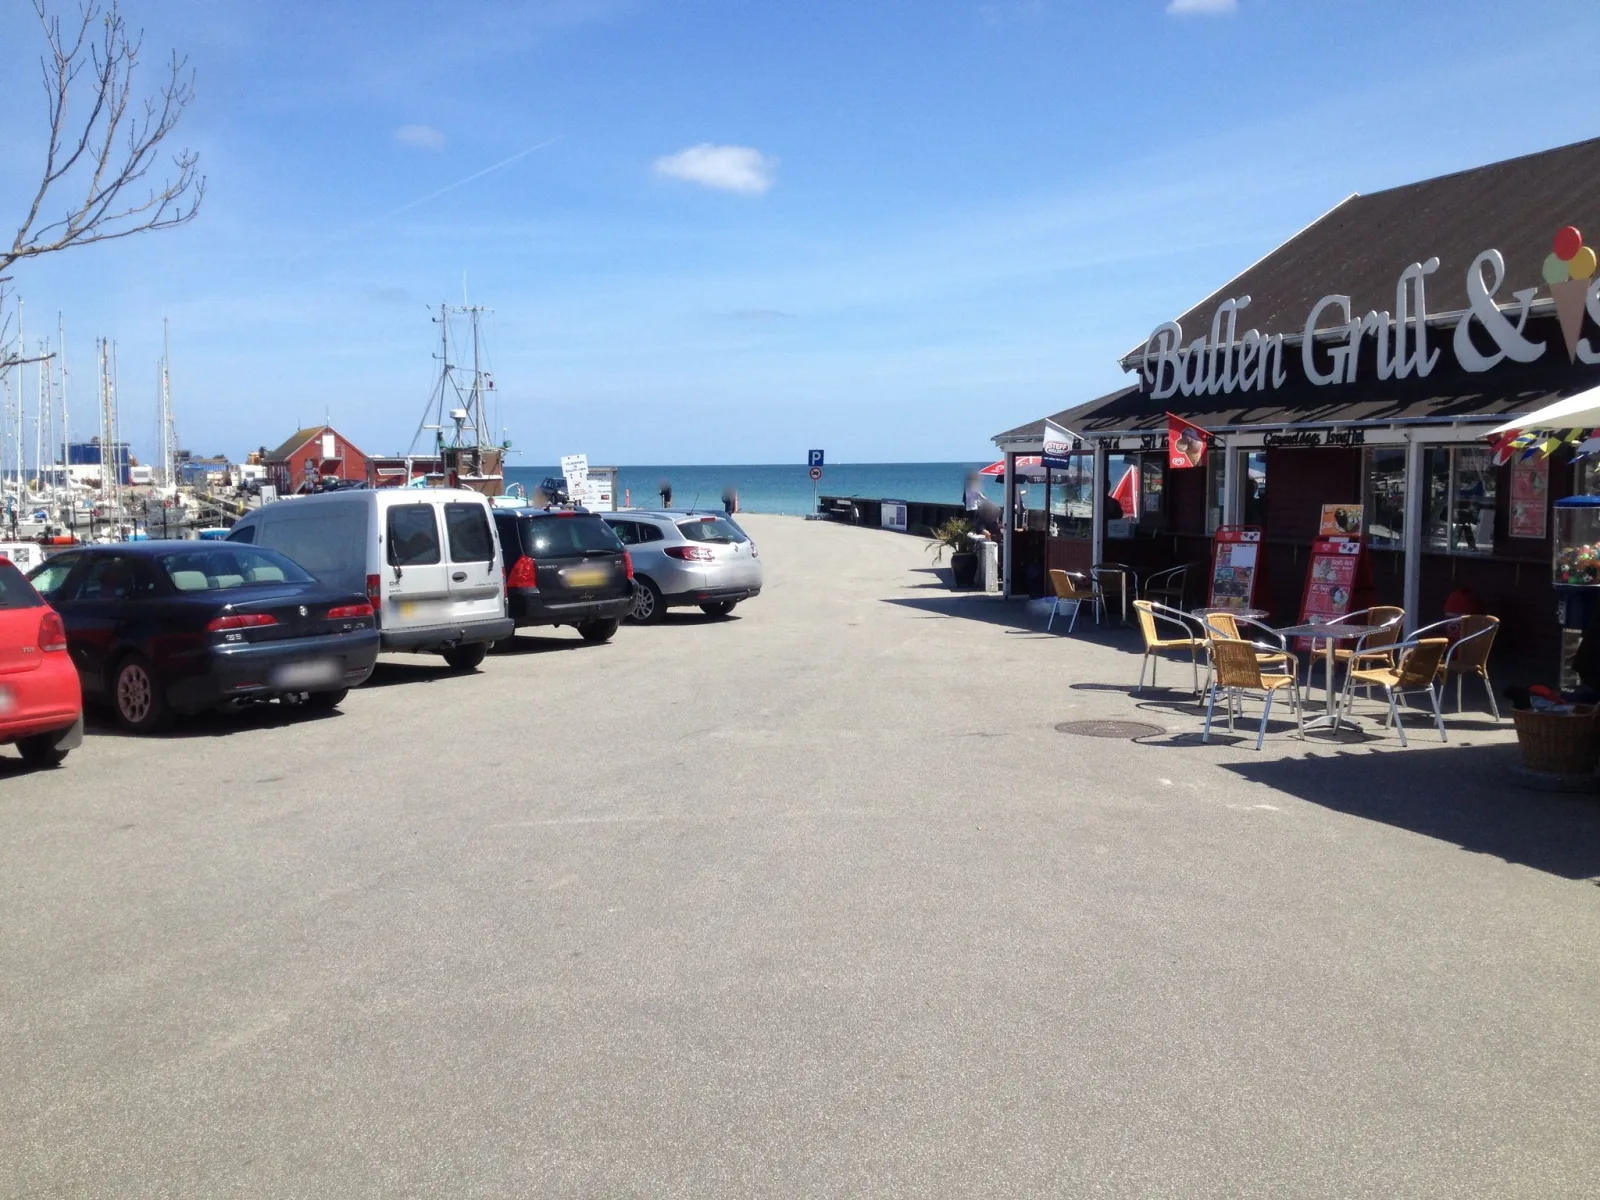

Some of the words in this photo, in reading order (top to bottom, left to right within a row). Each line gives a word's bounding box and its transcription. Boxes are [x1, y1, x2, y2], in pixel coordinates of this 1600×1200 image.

[1143, 295, 1287, 400] Ballen
[1302, 256, 1441, 386] Grill
[1453, 248, 1547, 373] &
[812, 452, 821, 465] P
